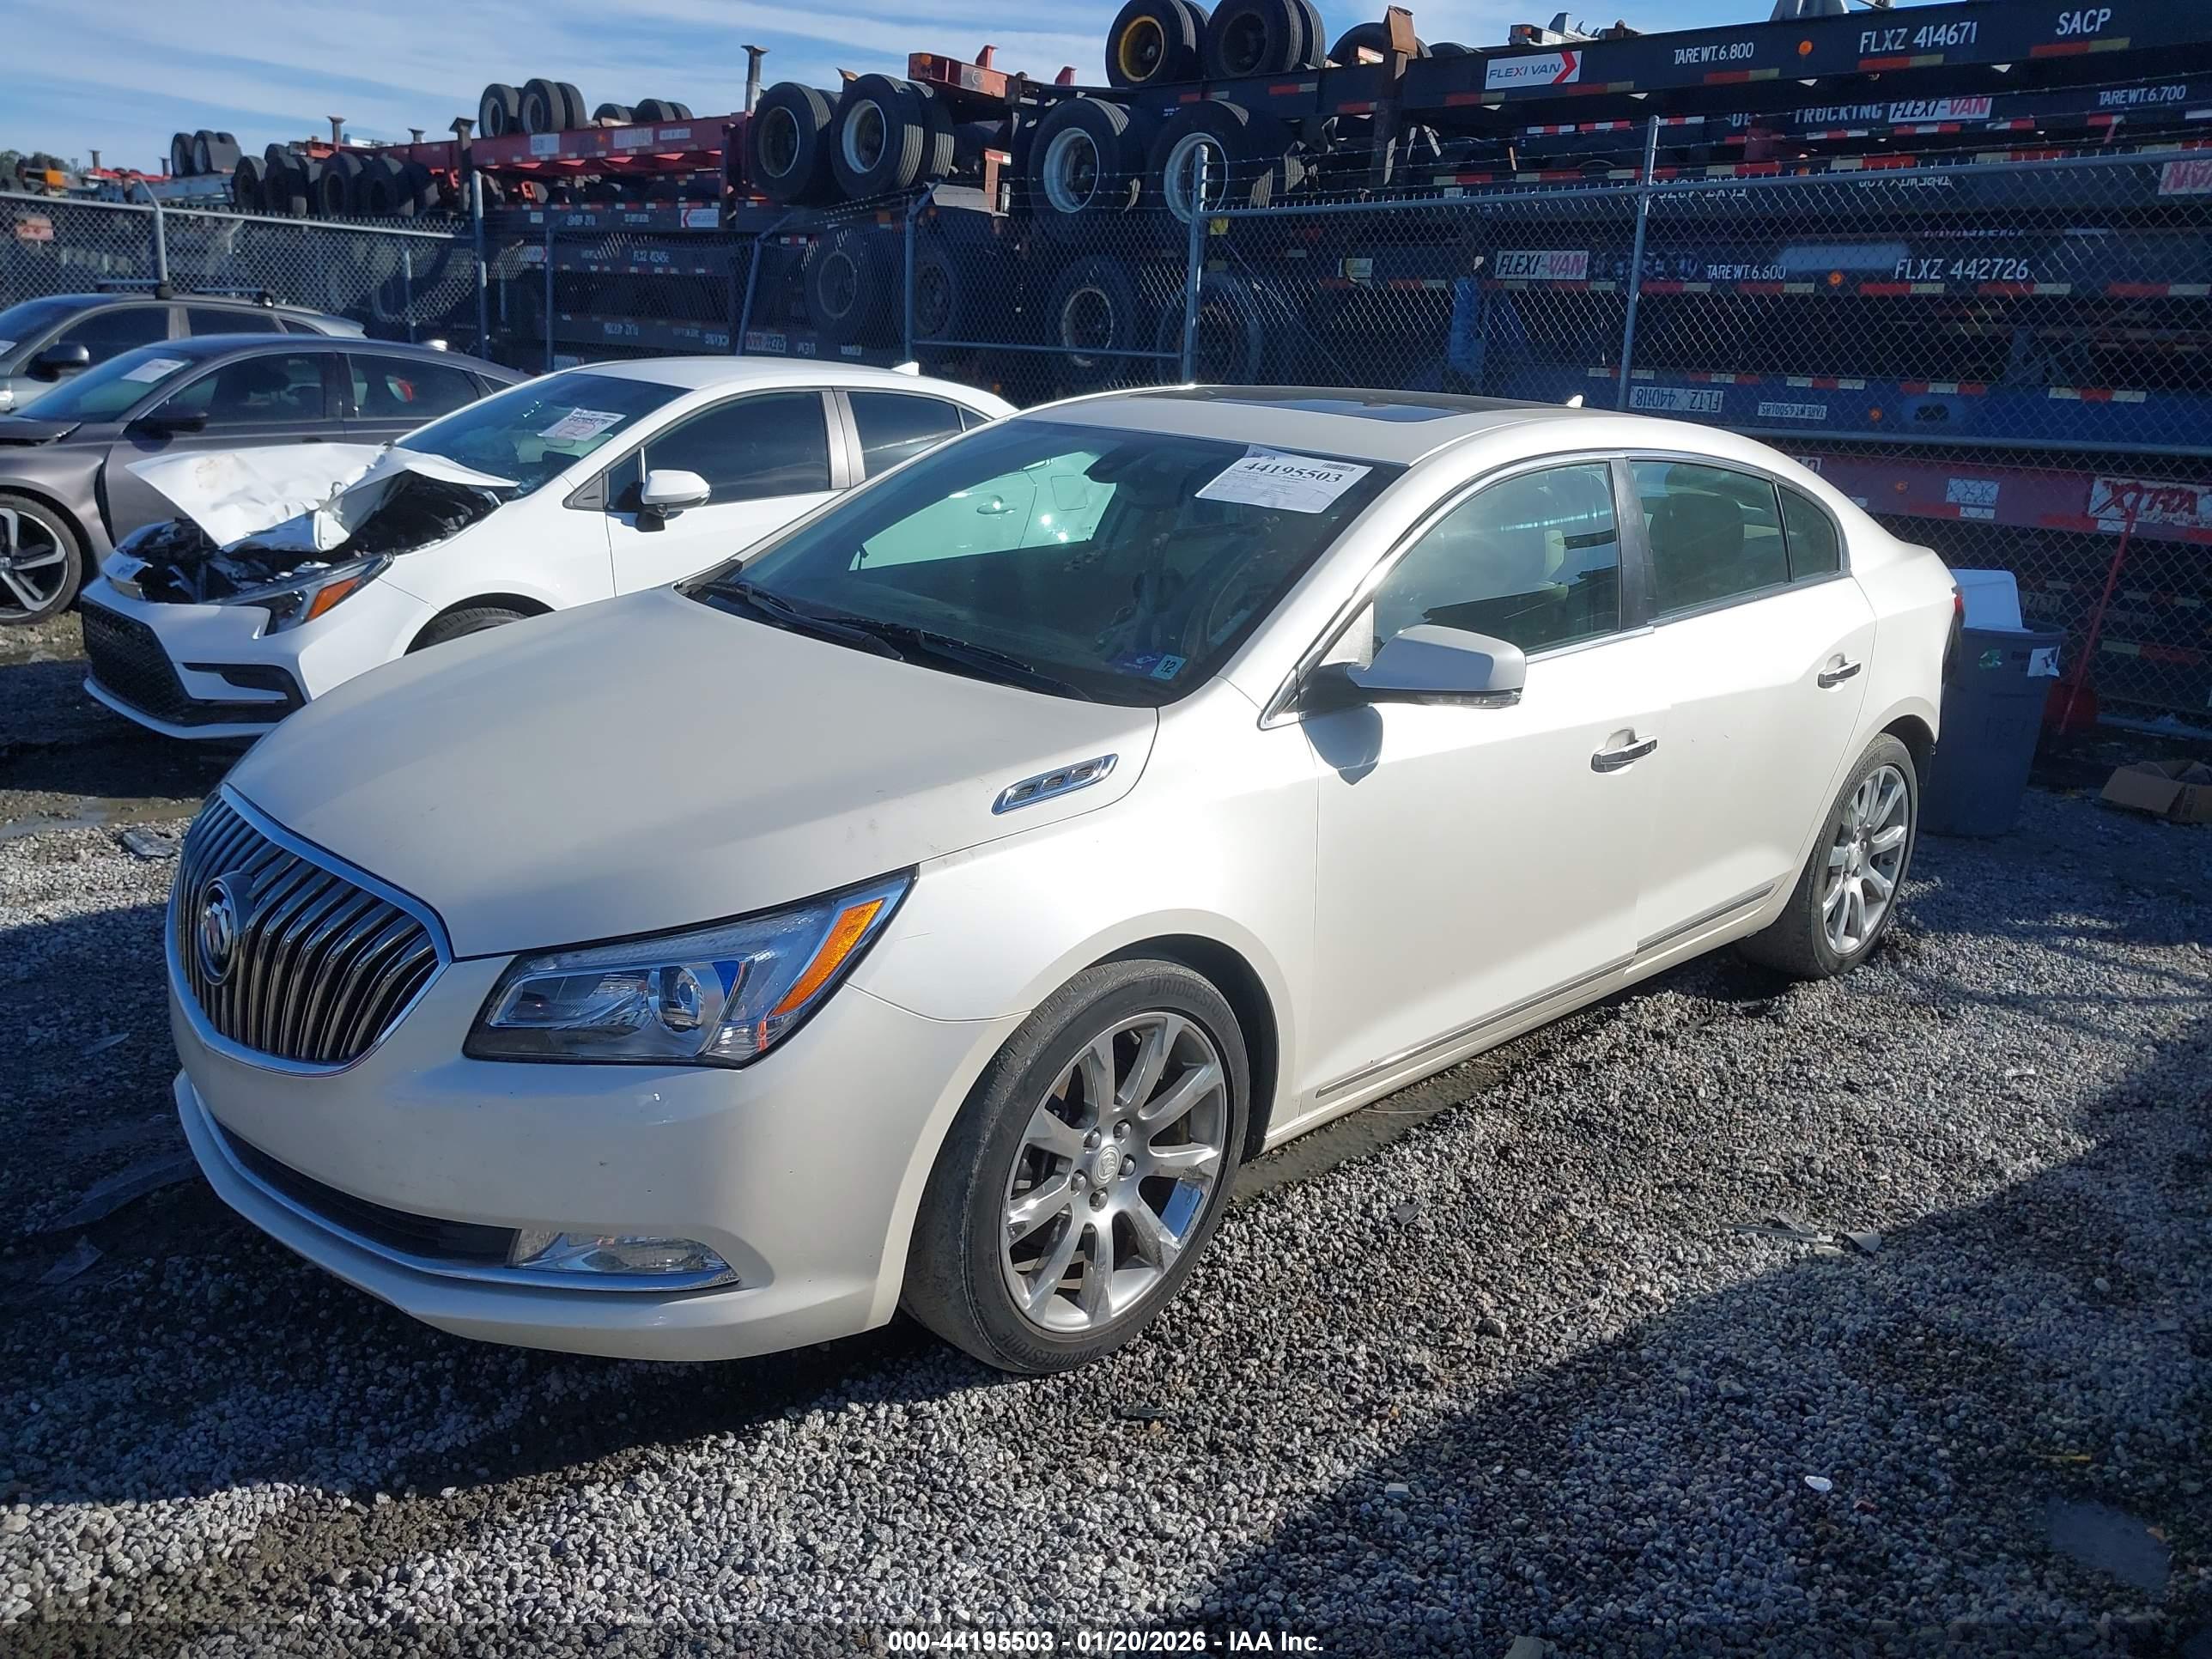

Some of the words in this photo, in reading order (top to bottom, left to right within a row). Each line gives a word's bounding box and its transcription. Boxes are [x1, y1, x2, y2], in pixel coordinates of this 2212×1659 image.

[2056, 8, 2112, 35] SACP
[1859, 27, 1908, 54] FLXZ
[1912, 21, 1978, 48] 414671
[1488, 66, 1528, 81] FLEXI
[1530, 62, 1562, 76] VAN
[1497, 253, 1585, 276] FLEXI-VAN
[1894, 258, 1945, 280] FLXZ
[1950, 258, 2030, 280] 442726
[1243, 462, 1343, 483] 44195503
